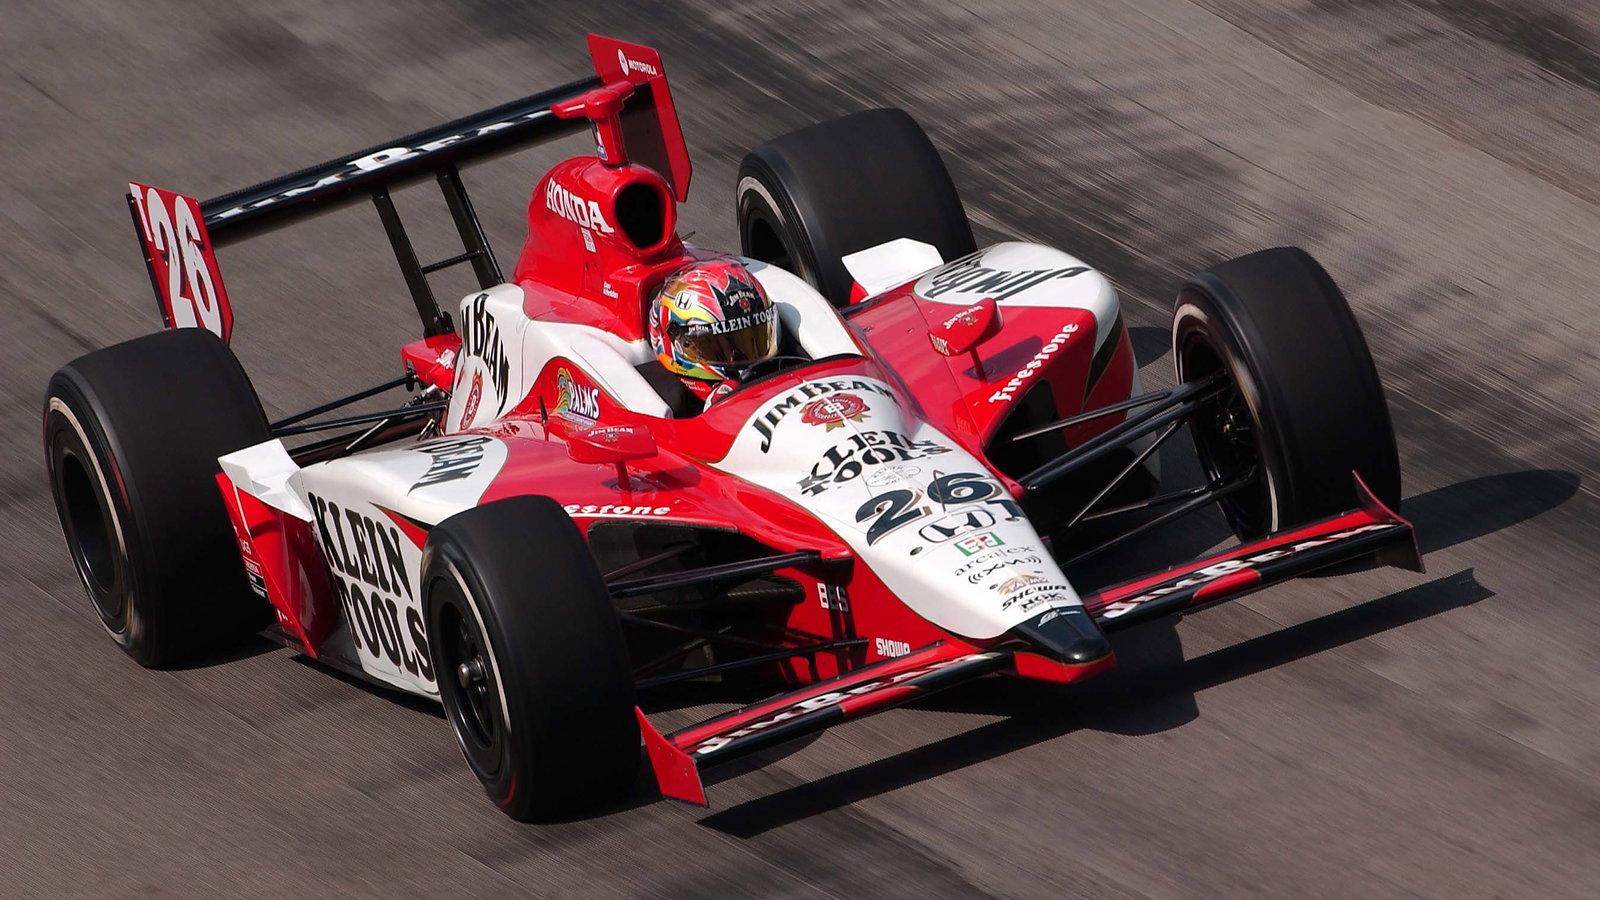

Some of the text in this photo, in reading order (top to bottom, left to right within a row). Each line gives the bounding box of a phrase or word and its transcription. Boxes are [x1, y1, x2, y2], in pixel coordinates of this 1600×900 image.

[627, 58, 658, 76] MOTOROLA
[546, 177, 615, 234] HONDA
[147, 187, 222, 338] 26
[711, 317, 751, 335] KLEIN
[989, 322, 1080, 404] Firestone
[568, 380, 599, 420] PALMS
[752, 394, 805, 455] JIM
[797, 380, 901, 406] BEAM
[587, 427, 634, 437] JIM BEAM
[796, 430, 940, 491] KLEIN
[801, 446, 953, 497] TOOLS
[854, 472, 1002, 547] 26
[307, 491, 414, 602] KLEIN
[817, 582, 849, 612] BBS
[1002, 585, 1067, 611] SHOWA
[332, 571, 436, 682] TOOLS
[875, 637, 911, 658] SHOWA
